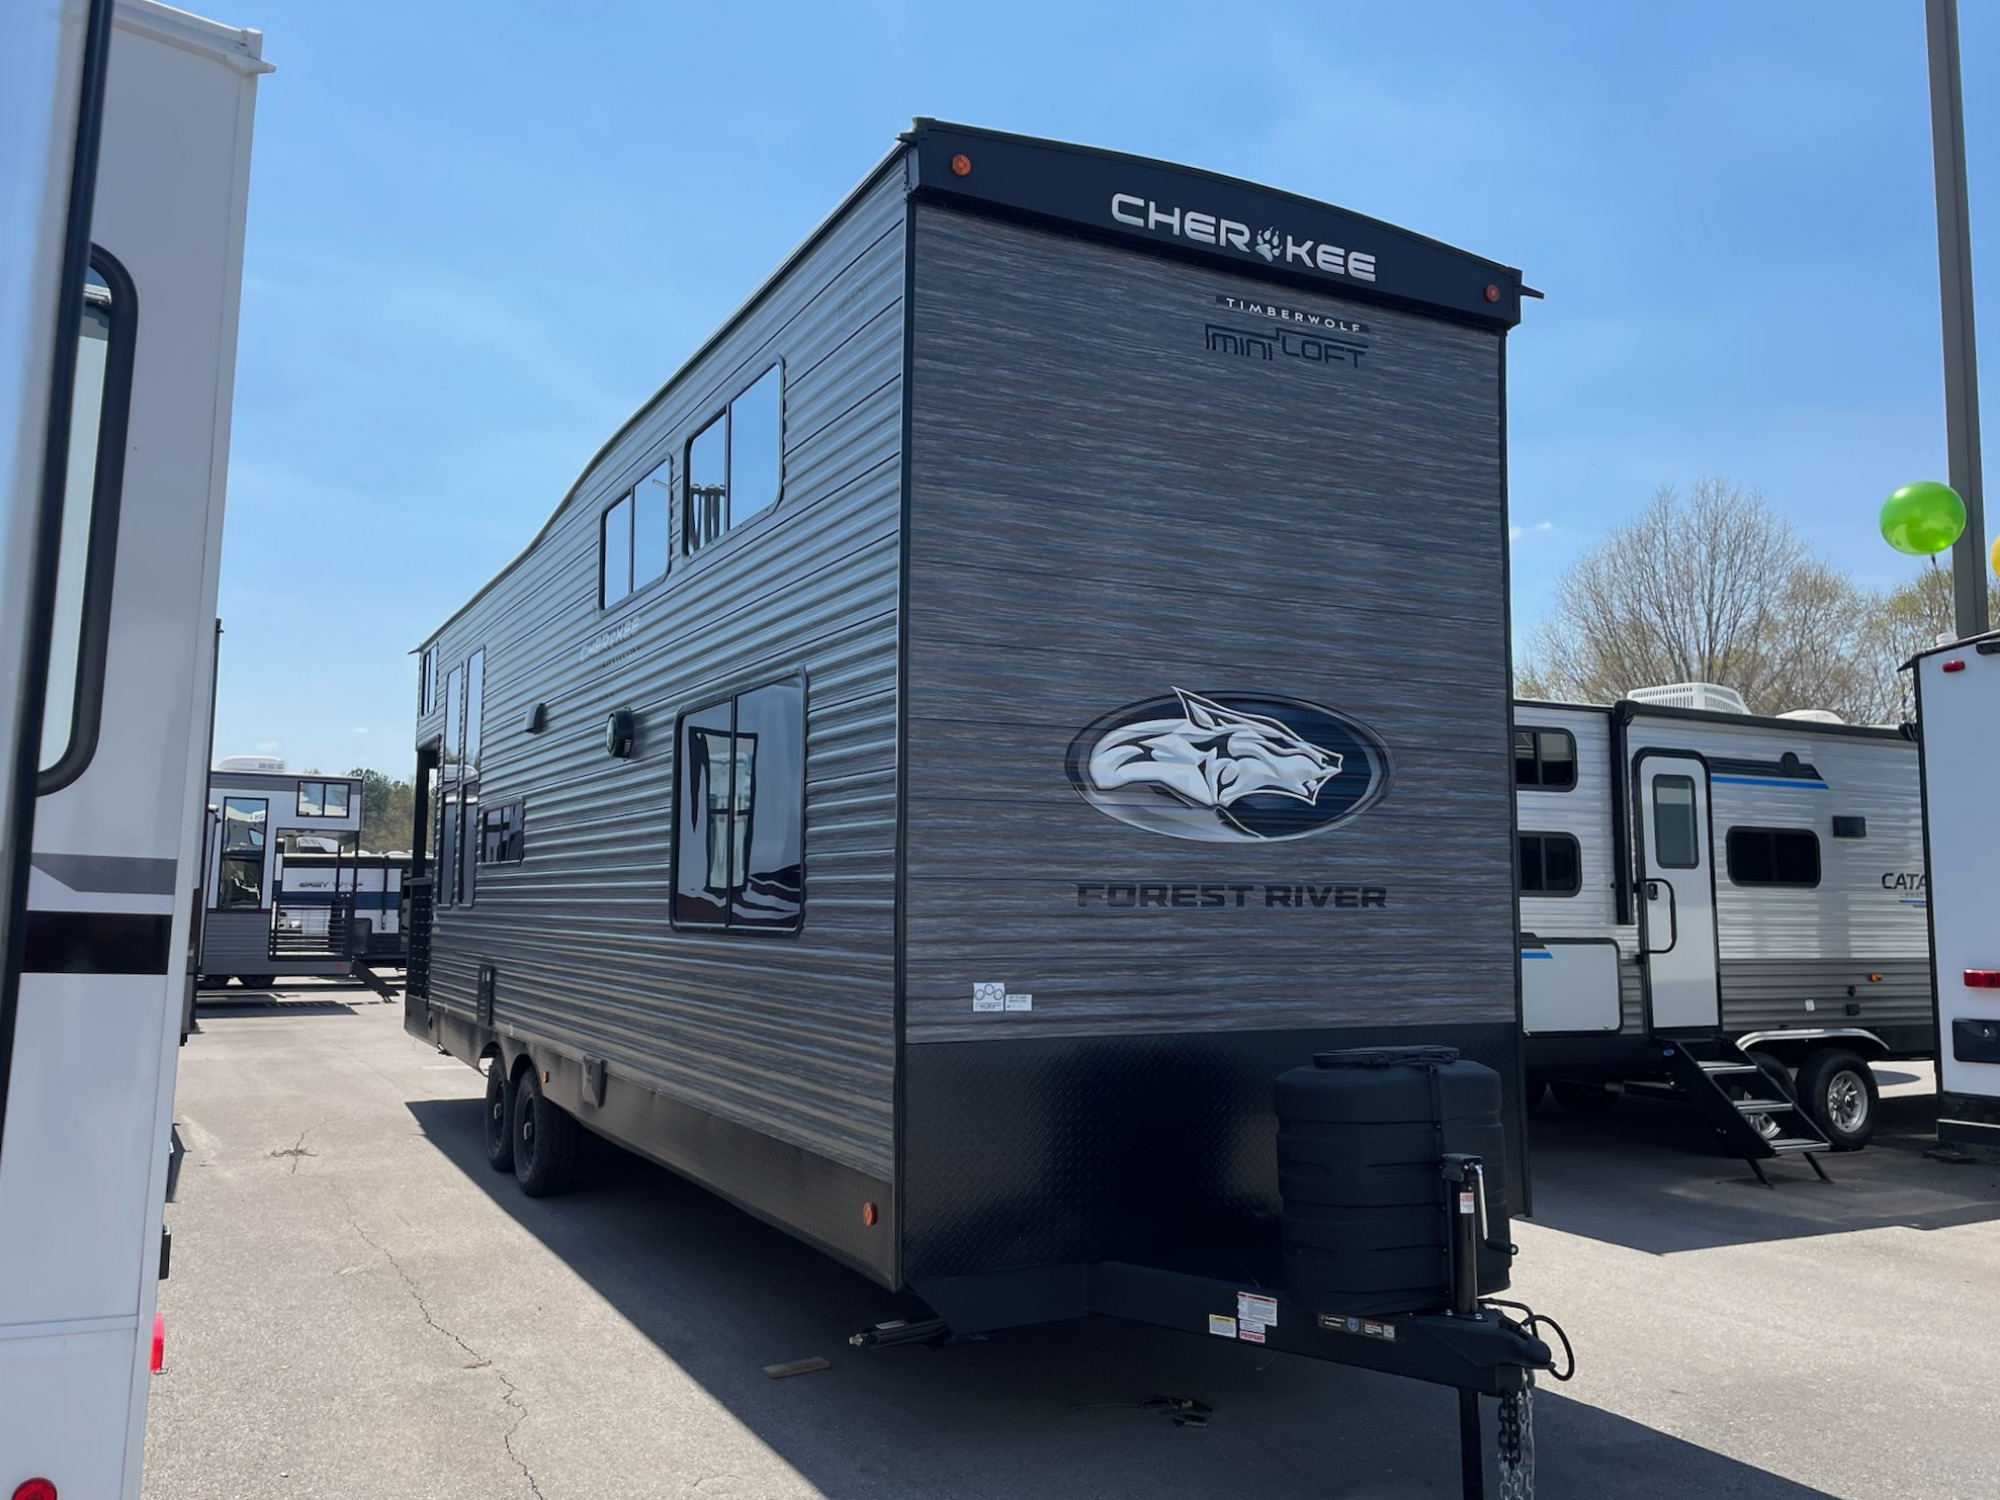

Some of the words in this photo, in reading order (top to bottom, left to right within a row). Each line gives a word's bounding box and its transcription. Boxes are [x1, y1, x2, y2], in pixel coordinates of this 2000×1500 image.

[1226, 298, 1361, 333] TIMBERWOLF
[1282, 335, 1367, 369] LOFT
[1076, 883, 1255, 908] FOREST
[1263, 885, 1388, 909] RIVER
